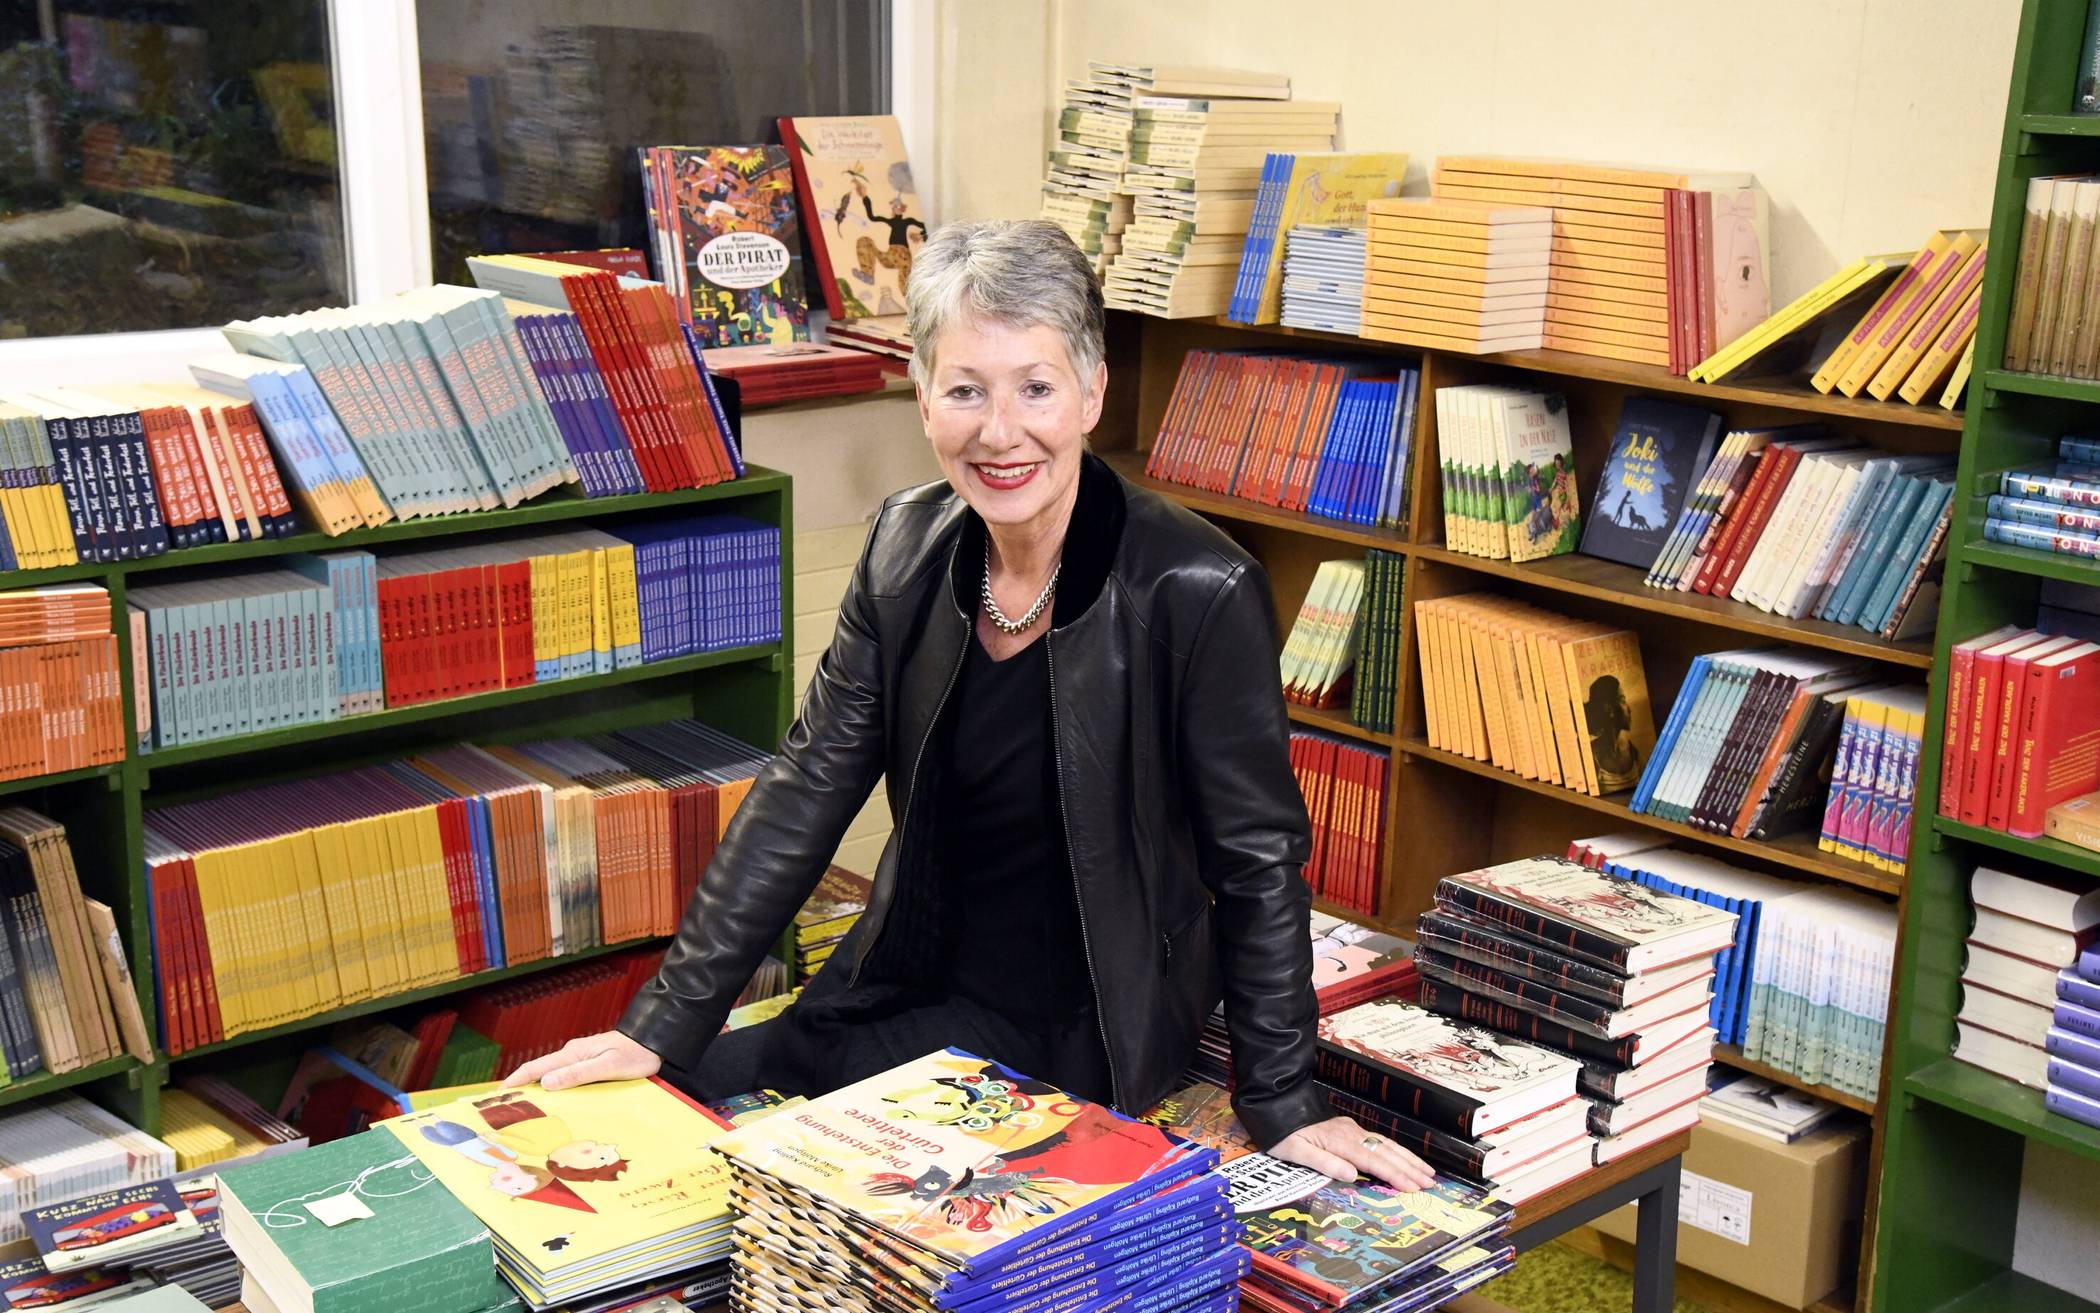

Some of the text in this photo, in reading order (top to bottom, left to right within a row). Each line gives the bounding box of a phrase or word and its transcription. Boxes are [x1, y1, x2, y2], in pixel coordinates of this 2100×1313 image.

[704, 249, 782, 266] DER PIRAT
[319, 370, 362, 437] SO WEIT OBEN
[343, 367, 385, 434] SO WEIT OBEN
[356, 365, 397, 432] SO WEIT OBEN
[1622, 432, 1658, 462] Joki
[59, 447, 75, 482] Federbett
[81, 447, 96, 480] Federbett
[100, 445, 114, 478] Federbett
[118, 443, 133, 476] Federbett
[134, 441, 149, 474] Federbett
[66, 483, 77, 496] und
[88, 482, 98, 494] und
[106, 480, 117, 492] und
[125, 478, 135, 490] und
[140, 476, 151, 488] und
[1975, 677, 1987, 718] KAKERLAKEN
[1947, 672, 1962, 745] TANZ DER KAKERLAKEN
[1973, 721, 1981, 733] DER
[1998, 681, 2014, 756] TANZ DER KAKERLAKEN
[1970, 736, 1980, 751] TANZ
[1779, 740, 1809, 794] HERZSTEINE
[2017, 739, 2035, 815] TANZ DER KAKERLAKEN
[2075, 831, 2100, 848] VISI
[844, 1108, 944, 1154] Gürteltiere
[795, 1114, 912, 1170] Die Entstehung
[876, 1139, 906, 1153] der
[800, 1161, 833, 1178] Rudyard
[1222, 1156, 1260, 1173] Robert
[1237, 1158, 1273, 1175] Steven
[1223, 1181, 1258, 1199] ER
[1249, 1161, 1301, 1183] PIR
[1233, 1169, 1313, 1206] nd der Apoth
[36, 1205, 78, 1220] KURZ
[86, 1194, 119, 1206] NACH
[1156, 1203, 1175, 1214] Kipling
[1177, 1195, 1199, 1209] Rudyard
[54, 1206, 98, 1221] KOMMT
[1018, 1170, 1192, 1254] Rudyard Kipling Ulrike Möltgen Die Entstehung der Gürteltiere
[1136, 1209, 1151, 1221] Ulrike
[1110, 1216, 1134, 1231] Möltgen
[1047, 1238, 1079, 1254] Entstehung
[1160, 1244, 1180, 1256] Kipling
[1181, 1236, 1203, 1248] Rudyard
[991, 1214, 1196, 1289] Rudyard Kipling Ulrike Möltgen Die Entstehung der Gürteltiere
[1035, 1251, 1045, 1260] der
[1140, 1250, 1157, 1263] Ulrike
[1001, 1255, 1034, 1272] Gürteltiere
[1006, 1221, 1203, 1300] Rudyard Kipling Ulrike Möltgen Die Entstehung der Gürteltiere
[1115, 1258, 1139, 1274] Möltgen
[692, 1277, 729, 1292] Apotheker
[1053, 1281, 1086, 1298] Entstehung
[1087, 1278, 1097, 1286] Die
[1041, 1294, 1051, 1303] der
